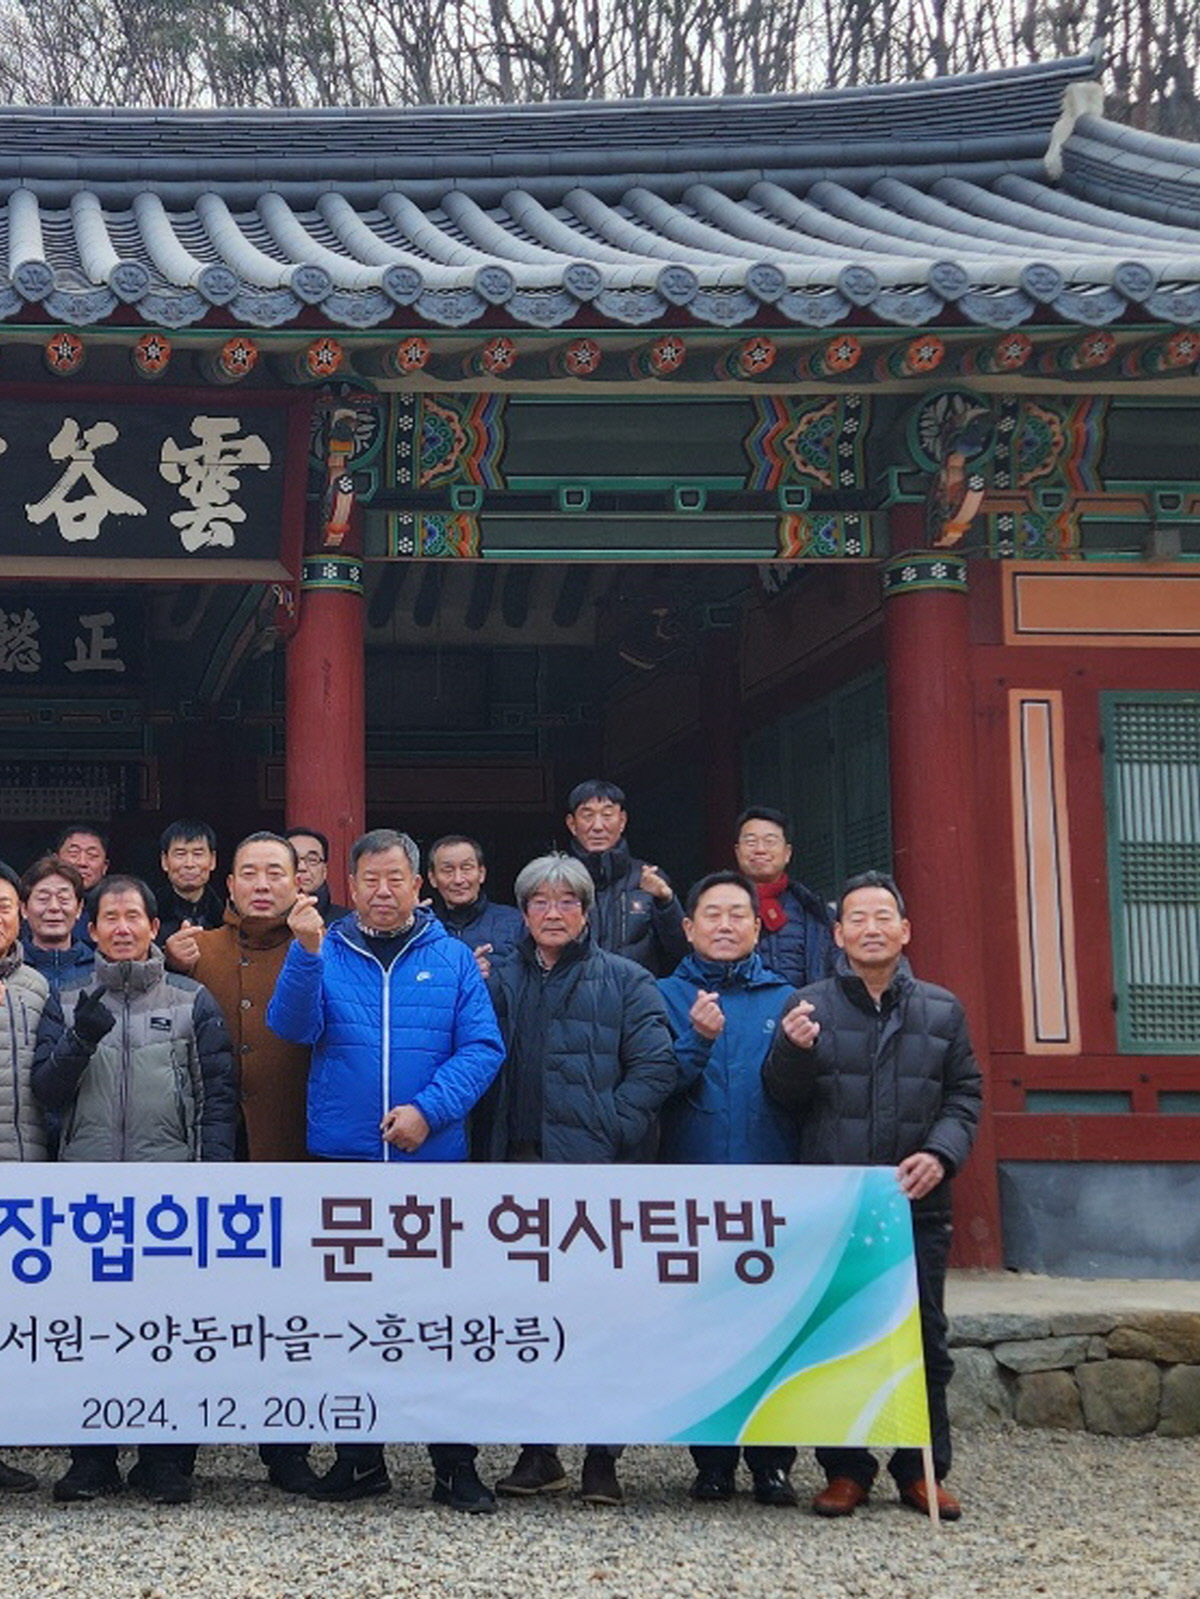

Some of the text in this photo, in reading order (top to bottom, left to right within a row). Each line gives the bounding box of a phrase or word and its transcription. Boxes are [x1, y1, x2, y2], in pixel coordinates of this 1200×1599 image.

[311, 1195, 464, 1283] 문화
[488, 1195, 786, 1285] 역사탐방
[82, 1394, 378, 1432] 2024. 12. 20.(금)
